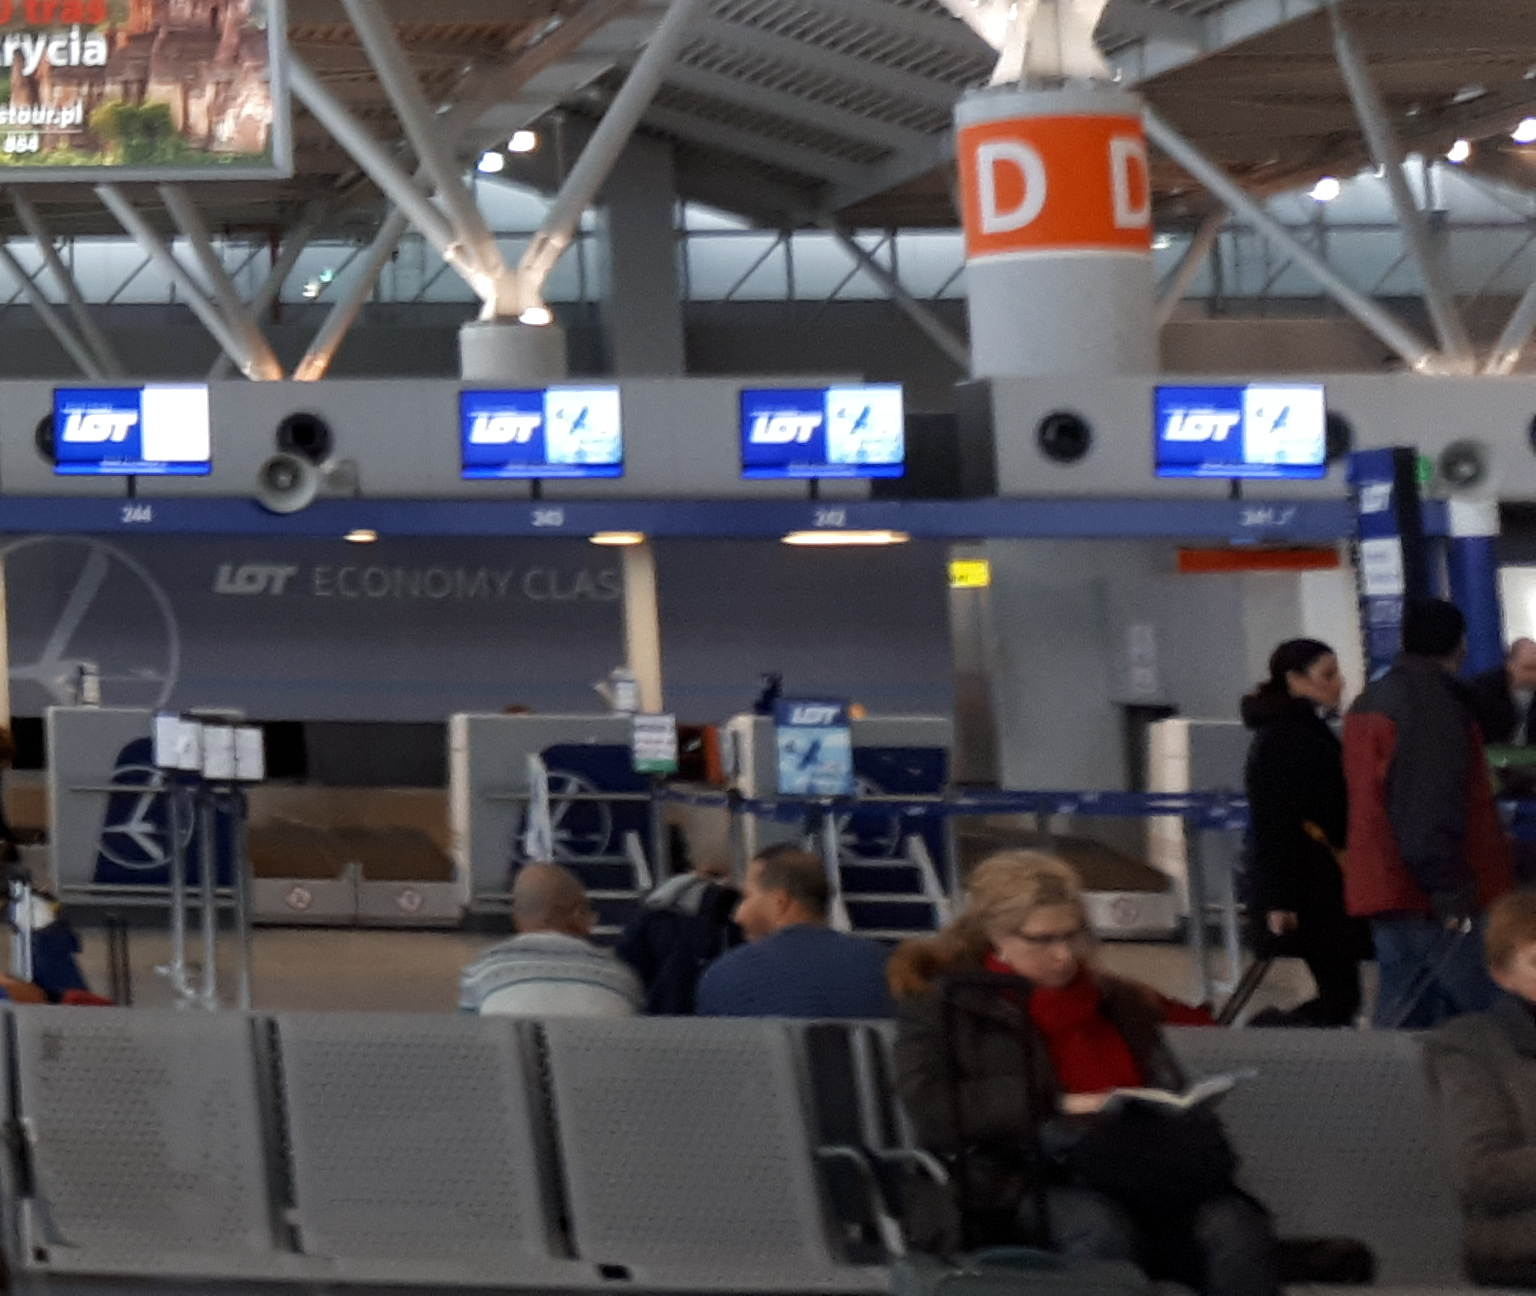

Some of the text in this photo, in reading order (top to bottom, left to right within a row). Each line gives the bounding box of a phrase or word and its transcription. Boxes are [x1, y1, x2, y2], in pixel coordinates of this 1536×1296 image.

[976, 140, 1047, 235] D
[1109, 137, 1151, 229] D
[62, 411, 138, 442] LOT
[469, 413, 542, 444] LOT
[749, 413, 823, 443] LOT
[1163, 411, 1240, 441] LOT
[213, 564, 623, 600] LOT ECONOMY CLAS
[790, 706, 841, 725] LOT
